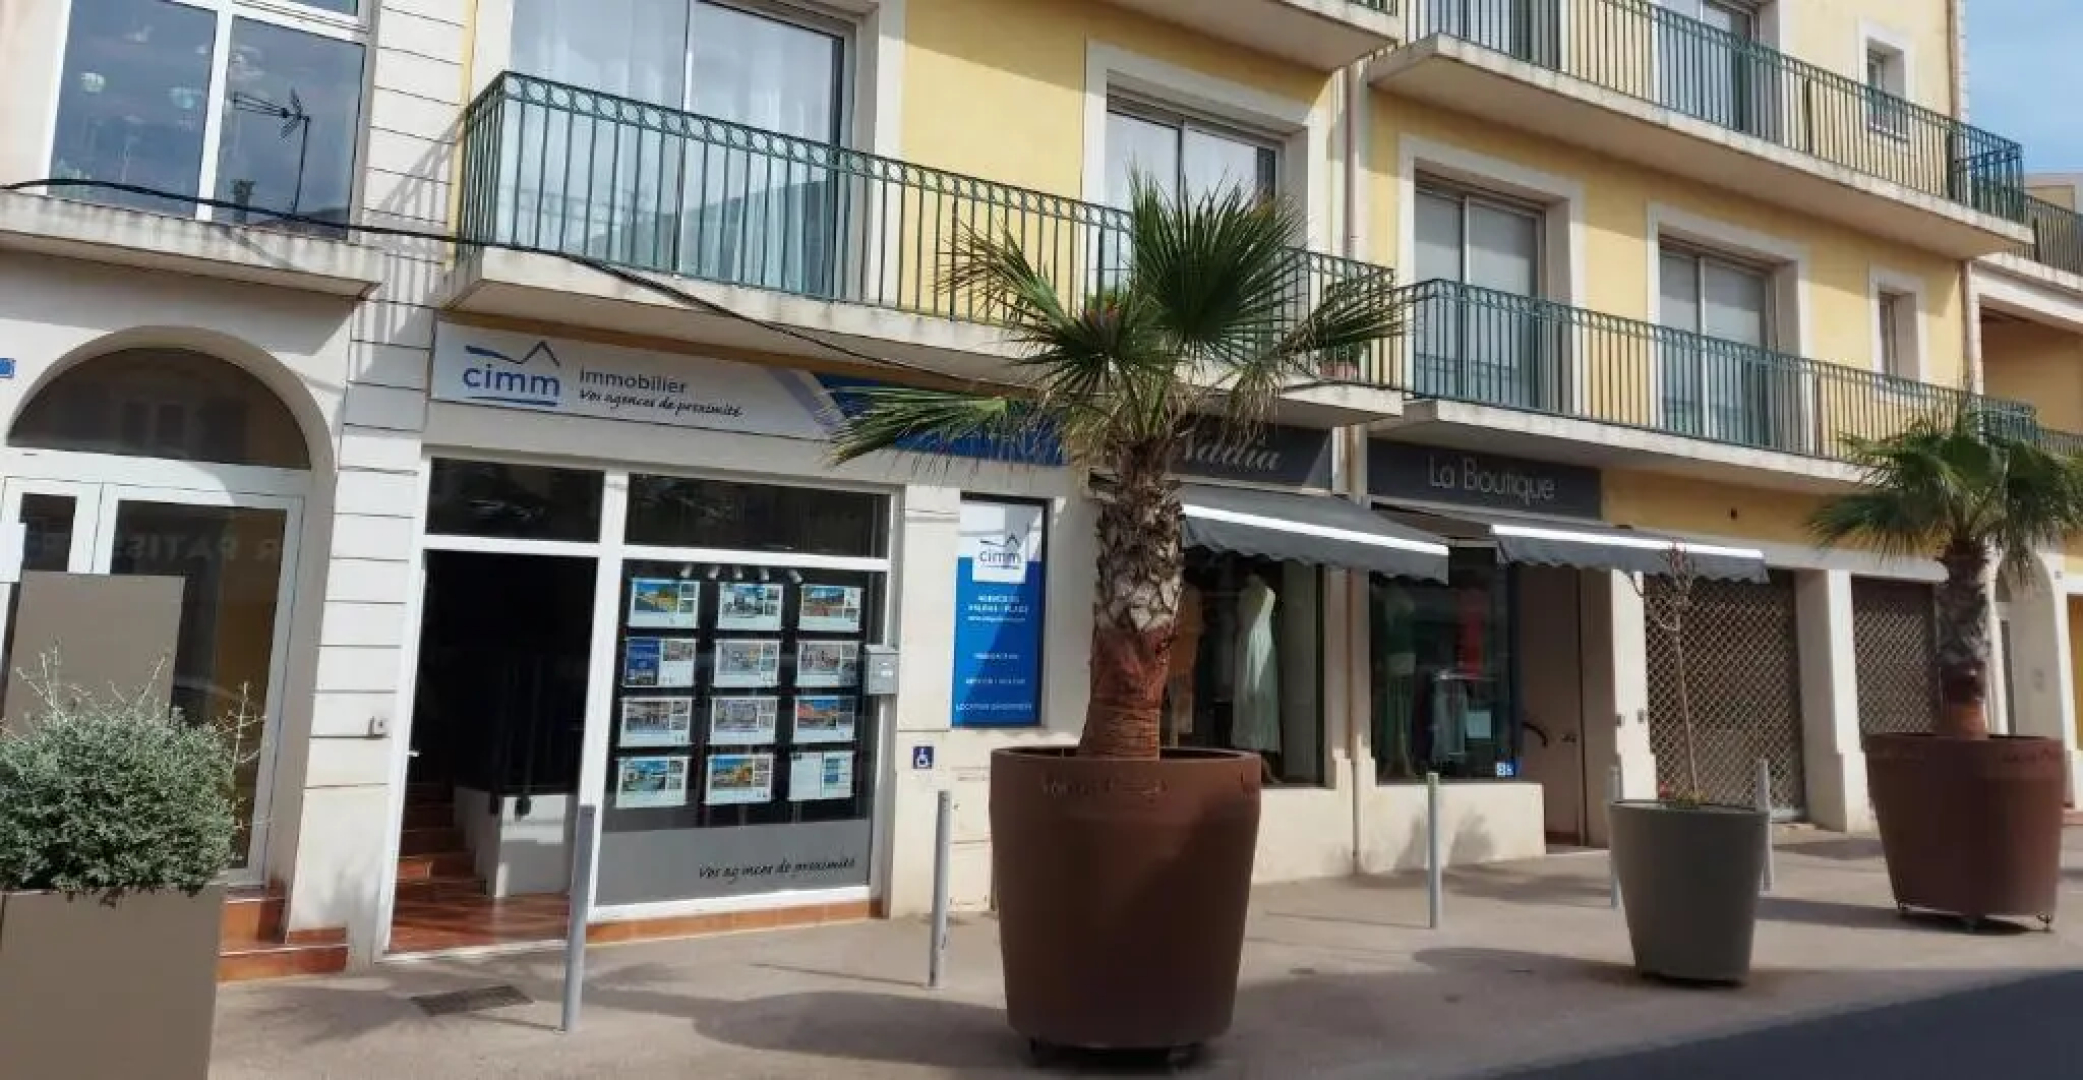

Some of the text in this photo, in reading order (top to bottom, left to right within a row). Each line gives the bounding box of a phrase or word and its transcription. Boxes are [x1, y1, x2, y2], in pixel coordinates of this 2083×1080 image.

[463, 364, 560, 397] cimm
[579, 388, 601, 401] Vos
[603, 393, 655, 410] agences
[658, 396, 676, 410] de
[1428, 454, 1555, 507] La Boutique
[979, 549, 1021, 566] cimm
